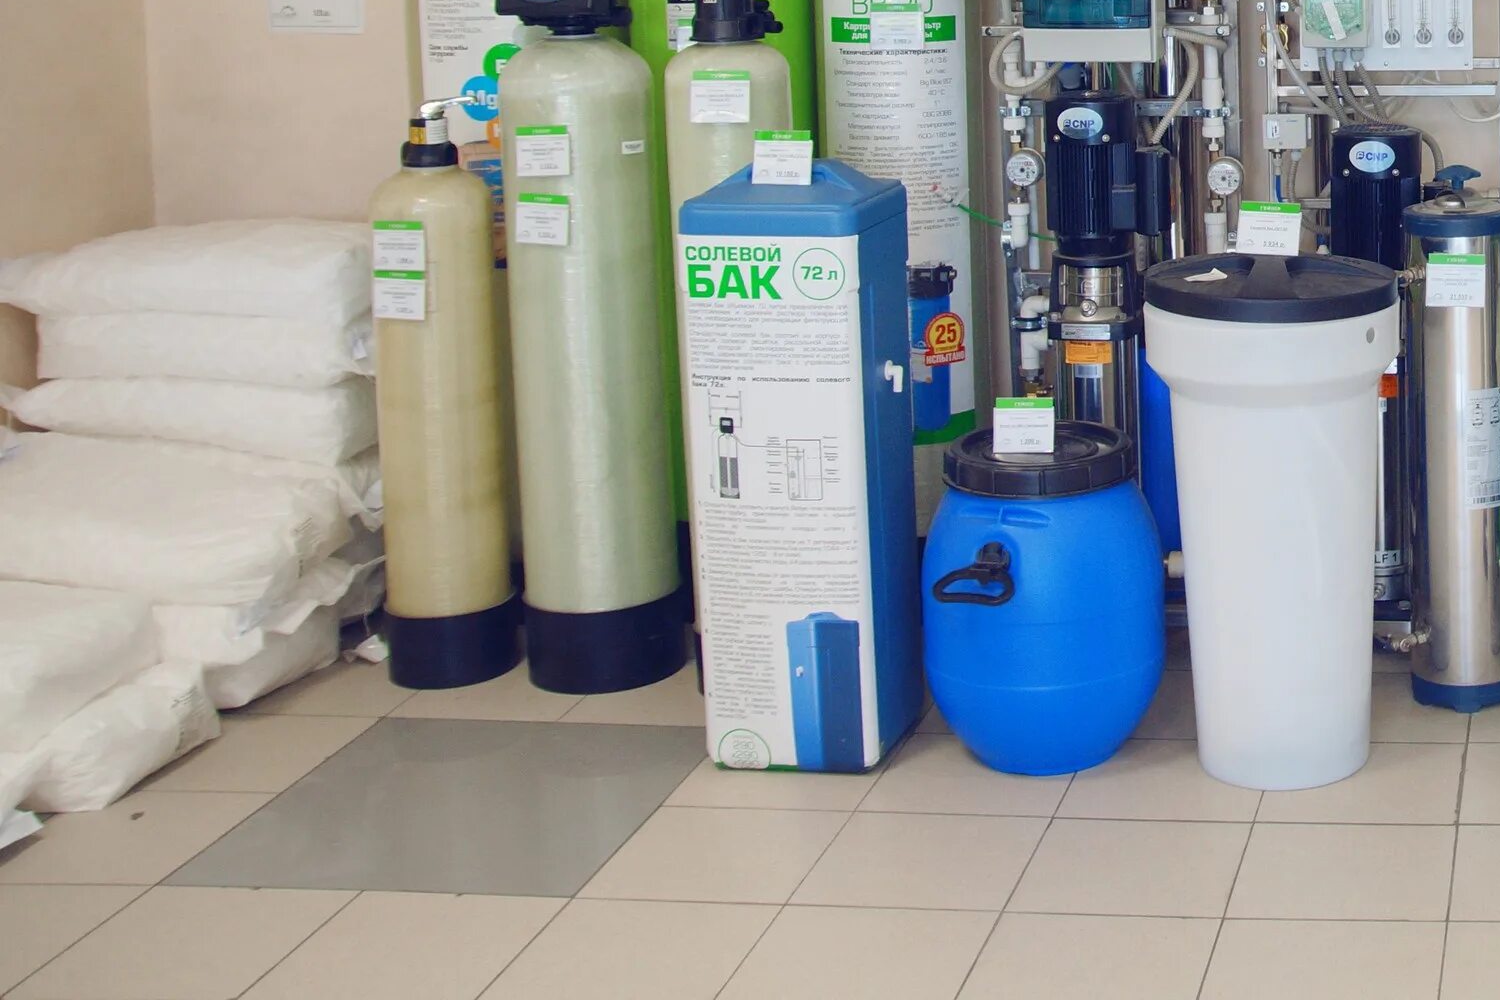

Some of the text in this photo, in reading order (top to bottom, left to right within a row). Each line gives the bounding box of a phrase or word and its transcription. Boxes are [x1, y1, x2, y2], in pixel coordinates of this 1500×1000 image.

[851, 32, 868, 40] для
[839, 48, 948, 56] Технические характеристики:
[1072, 119, 1096, 129] CNP
[1365, 152, 1389, 161] CNP
[685, 243, 781, 262] СОЛЕВОЙ
[801, 266, 838, 281] 72 л
[687, 264, 782, 300] БАК
[935, 323, 957, 345] 25
